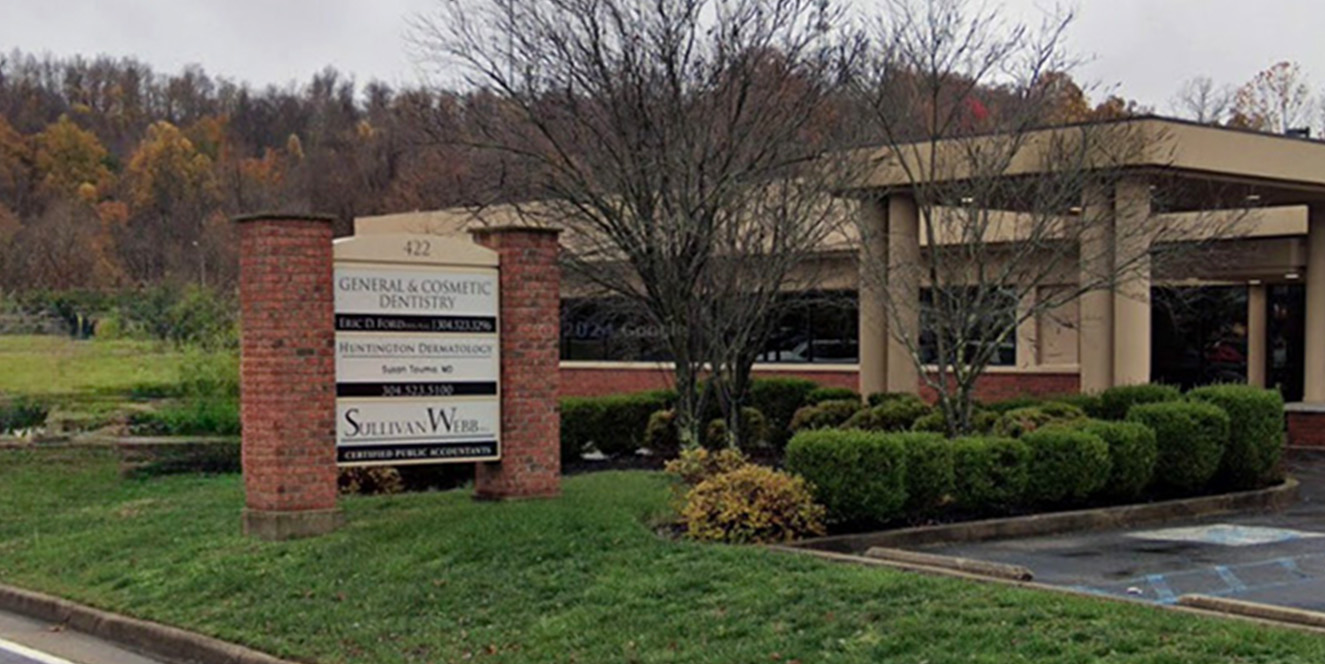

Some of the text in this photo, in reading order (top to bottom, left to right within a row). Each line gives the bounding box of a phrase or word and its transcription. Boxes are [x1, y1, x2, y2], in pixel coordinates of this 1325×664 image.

[404, 240, 431, 257] 422
[339, 276, 492, 296] GENERAL & COSMETIC
[379, 294, 456, 309] DENTISTRY
[339, 318, 363, 328] ERIC
[339, 342, 493, 354] HUNTINGTON DERMATOLOGY
[344, 446, 492, 459] CERTIFIED PUBLIC ACCOUNTANTS
